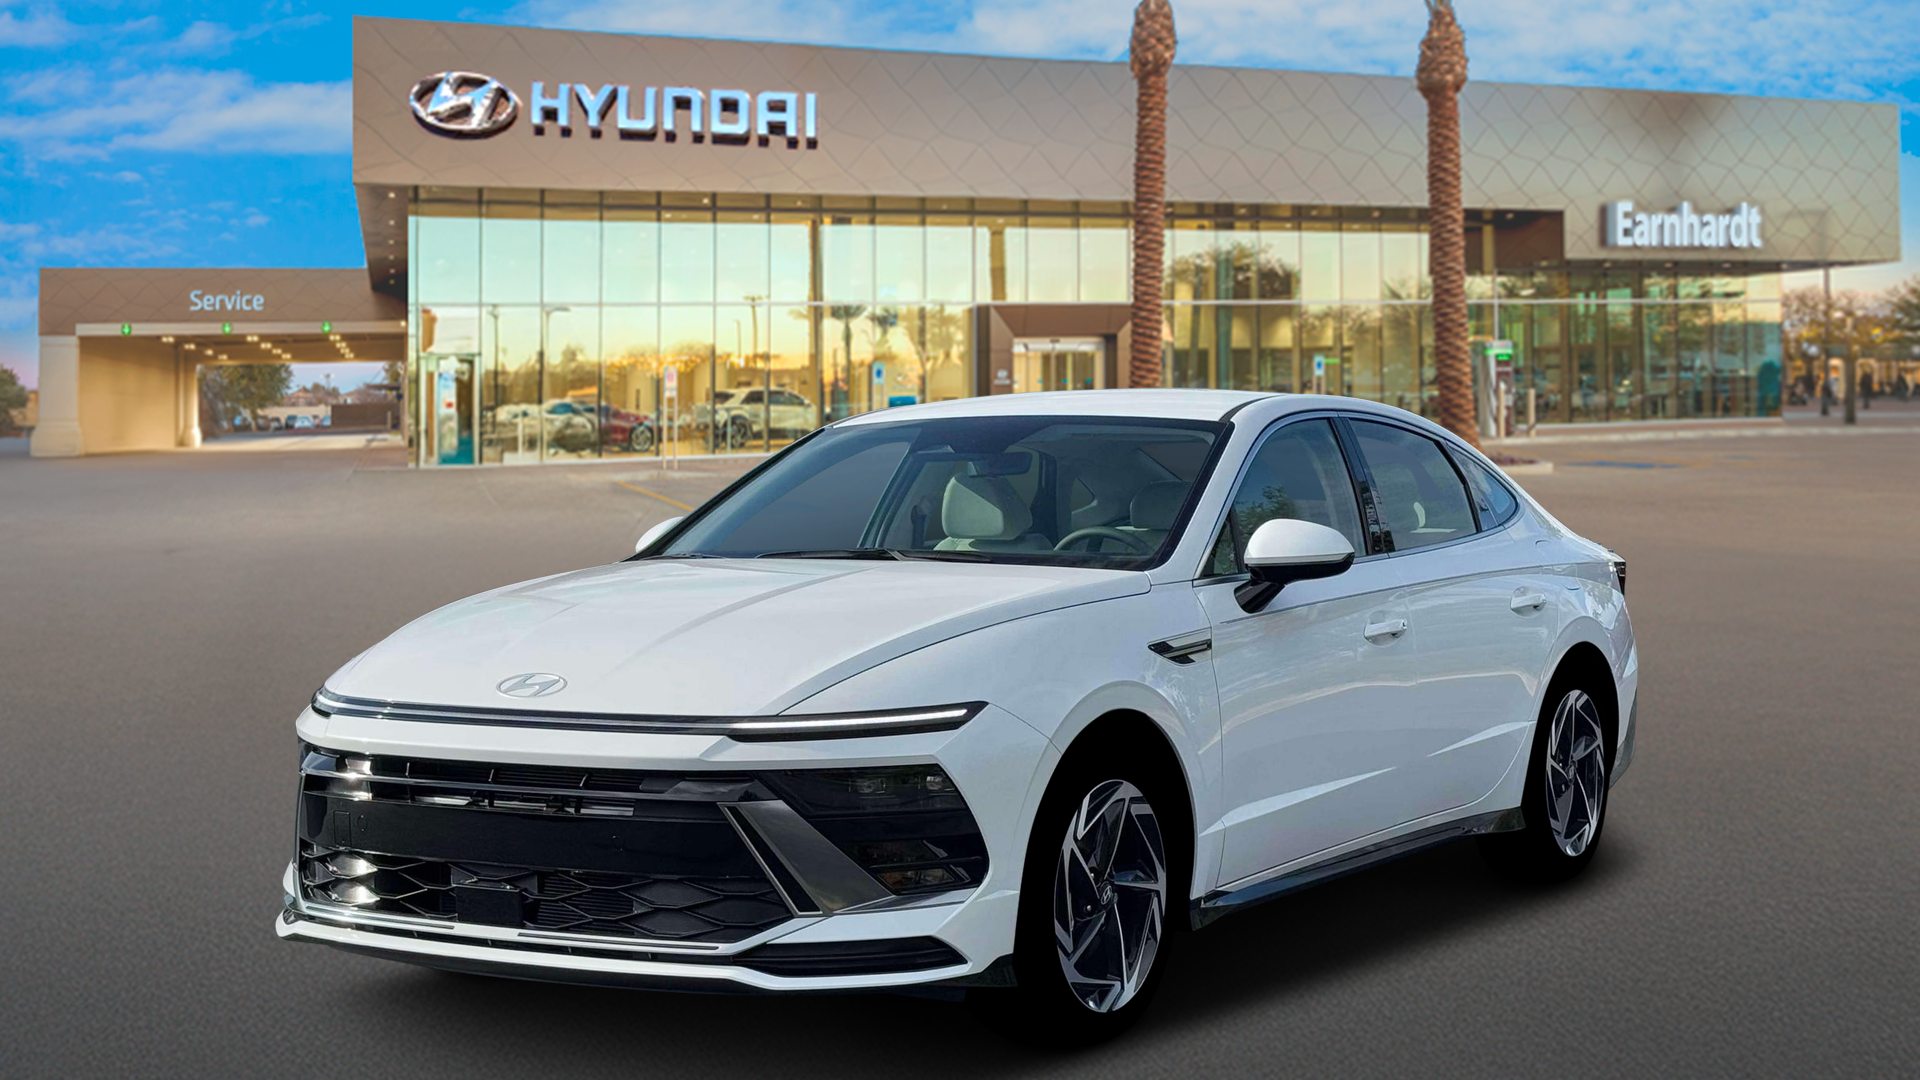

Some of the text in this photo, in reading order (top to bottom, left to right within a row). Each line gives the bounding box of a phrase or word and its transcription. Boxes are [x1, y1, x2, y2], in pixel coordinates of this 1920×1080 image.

[531, 81, 818, 146] HYUNDAI
[1608, 200, 1763, 248] Earnhardt
[189, 289, 265, 312] Service
